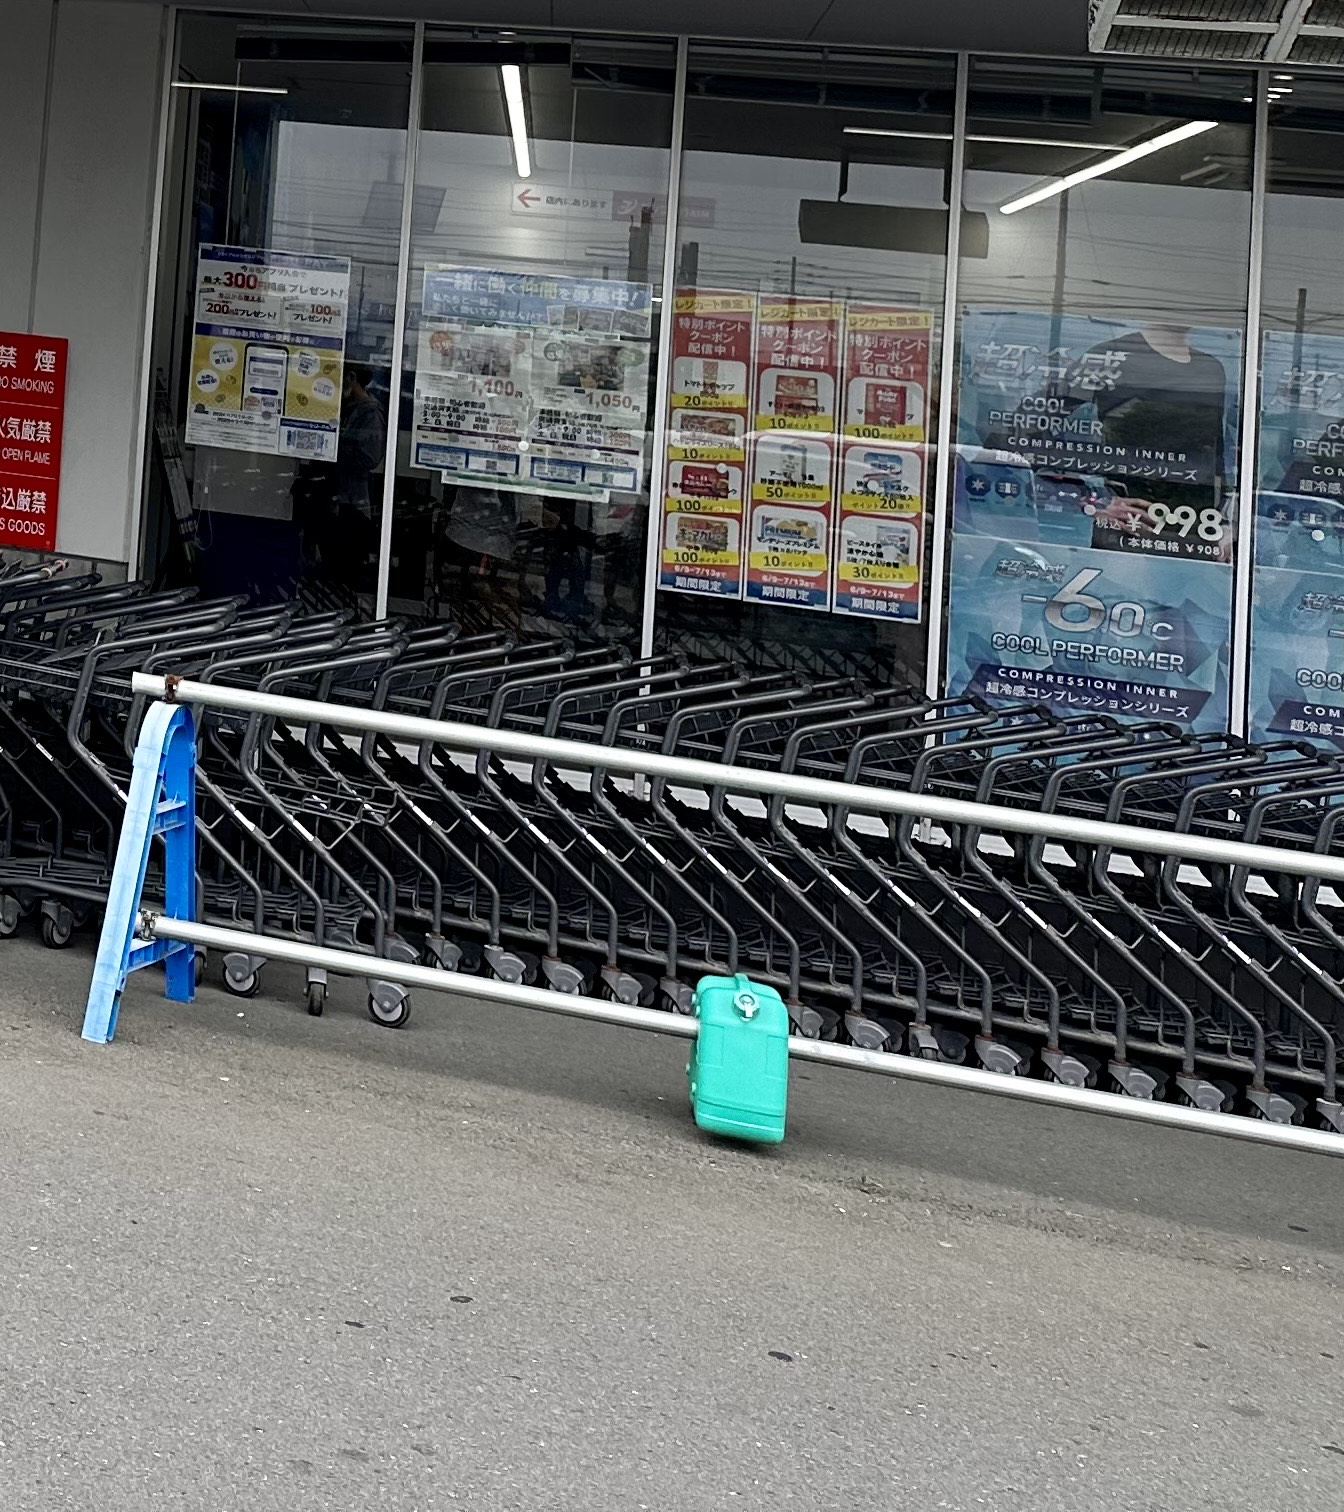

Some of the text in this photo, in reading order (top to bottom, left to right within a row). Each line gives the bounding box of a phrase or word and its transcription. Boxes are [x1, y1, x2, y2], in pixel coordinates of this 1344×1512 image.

[678, 316, 745, 333] 特別ポイント
[761, 324, 837, 342] 特別ポイント
[690, 330, 734, 343] クーポン
[849, 333, 927, 351] 特別ポイント
[773, 340, 823, 353] クーポン
[861, 348, 913, 362] クーポン
[970, 341, 1131, 391] 超冷感
[11, 377, 55, 394] SMOKING
[1021, 396, 1072, 415] COOL
[988, 410, 1104, 438] PERFORMER
[2, 447, 23, 462] OPEN
[24, 449, 51, 465] FLAME
[1007, 437, 1187, 463] COMPRESSION INNER
[995, 450, 1198, 481] 超冷感コンプレッションシリーズ
[7, 518, 45, 536] GOODS
[1095, 516, 1122, 531] 税込
[675, 575, 722, 592] 期間限定
[761, 585, 810, 602] 期間限定
[851, 597, 900, 614] 期間限定
[992, 632, 1185, 674] COOL PERFORMER
[997, 667, 1179, 700] COMPRESSION INNER
[1296, 667, 1344, 691] COO
[985, 681, 1190, 718] 超冷感コンプレッションシリーズ
